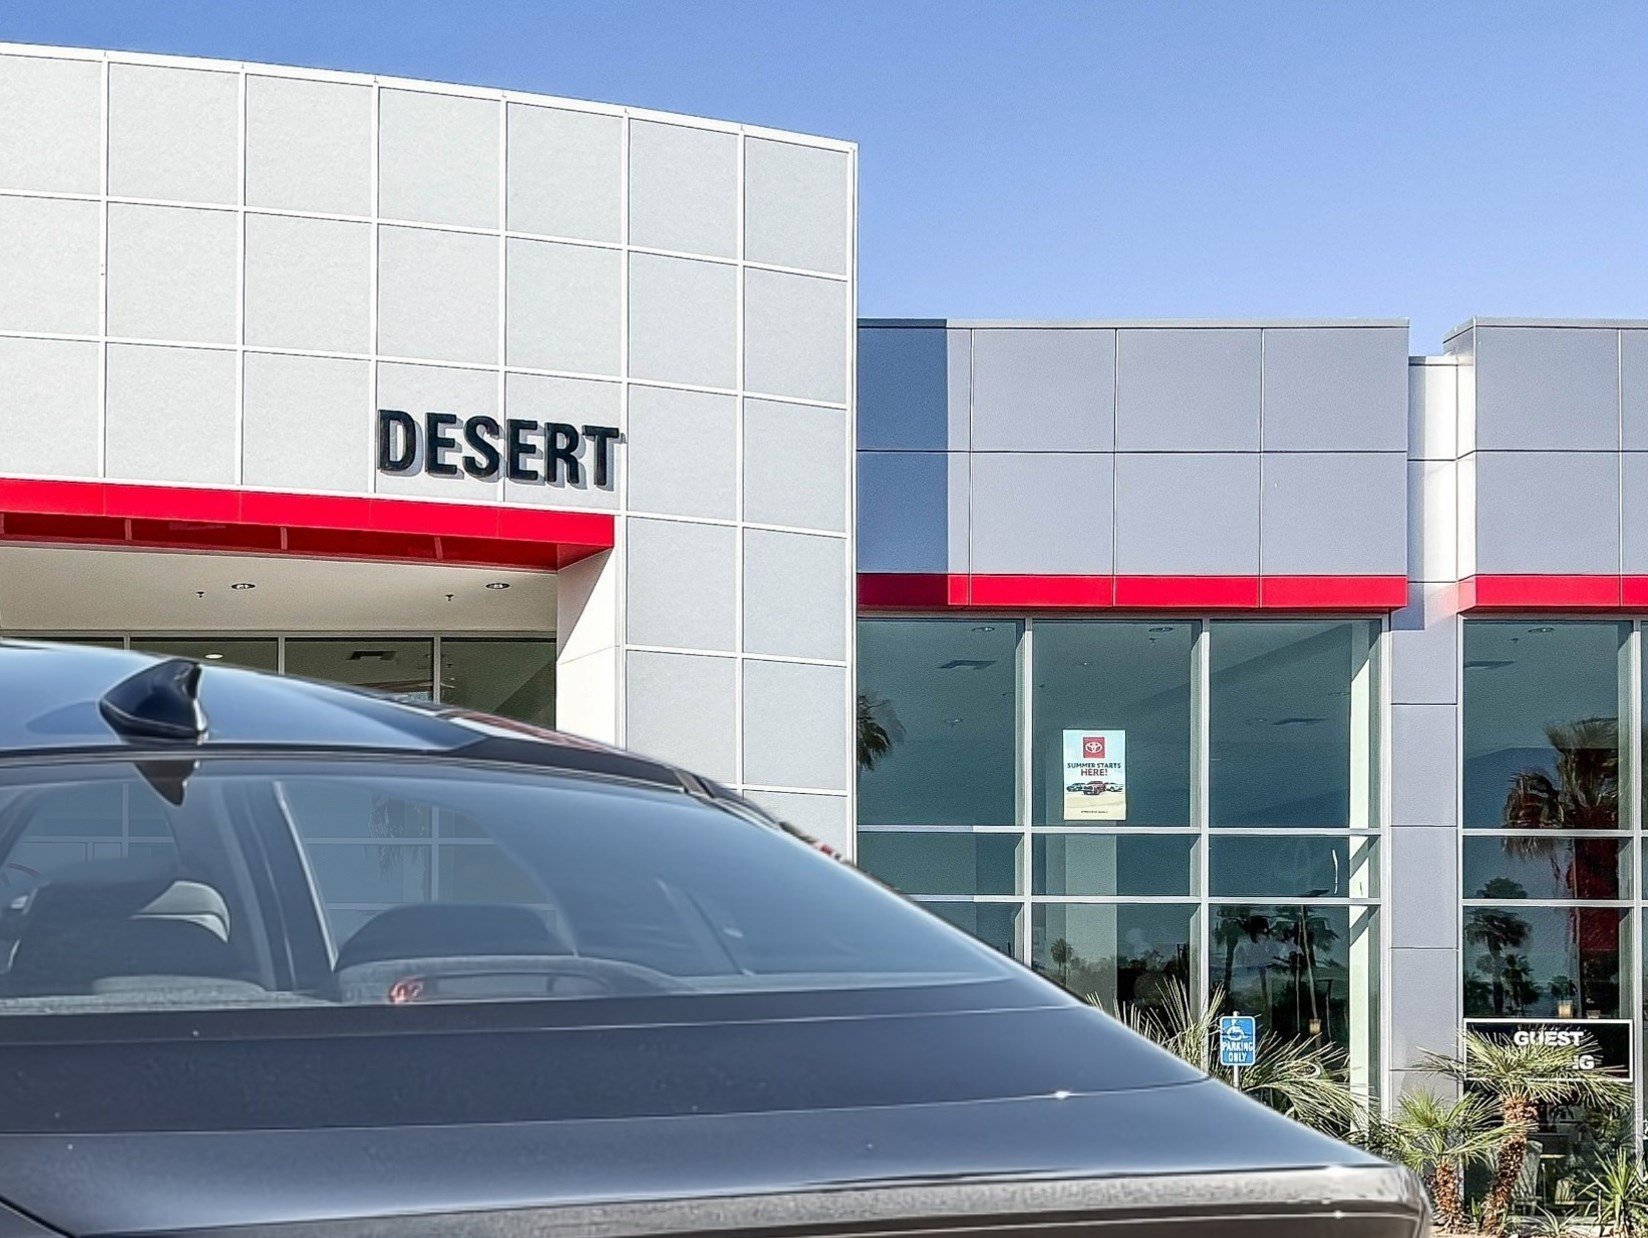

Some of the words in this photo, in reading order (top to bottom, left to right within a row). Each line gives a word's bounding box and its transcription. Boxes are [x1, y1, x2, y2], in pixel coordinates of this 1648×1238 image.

[377, 409, 620, 487] DESERT
[1080, 768, 1108, 777] HERE!
[1513, 1031, 1584, 1047] GUEST
[1222, 1041, 1254, 1052] PARKING
[1228, 1052, 1248, 1063] ONLY
